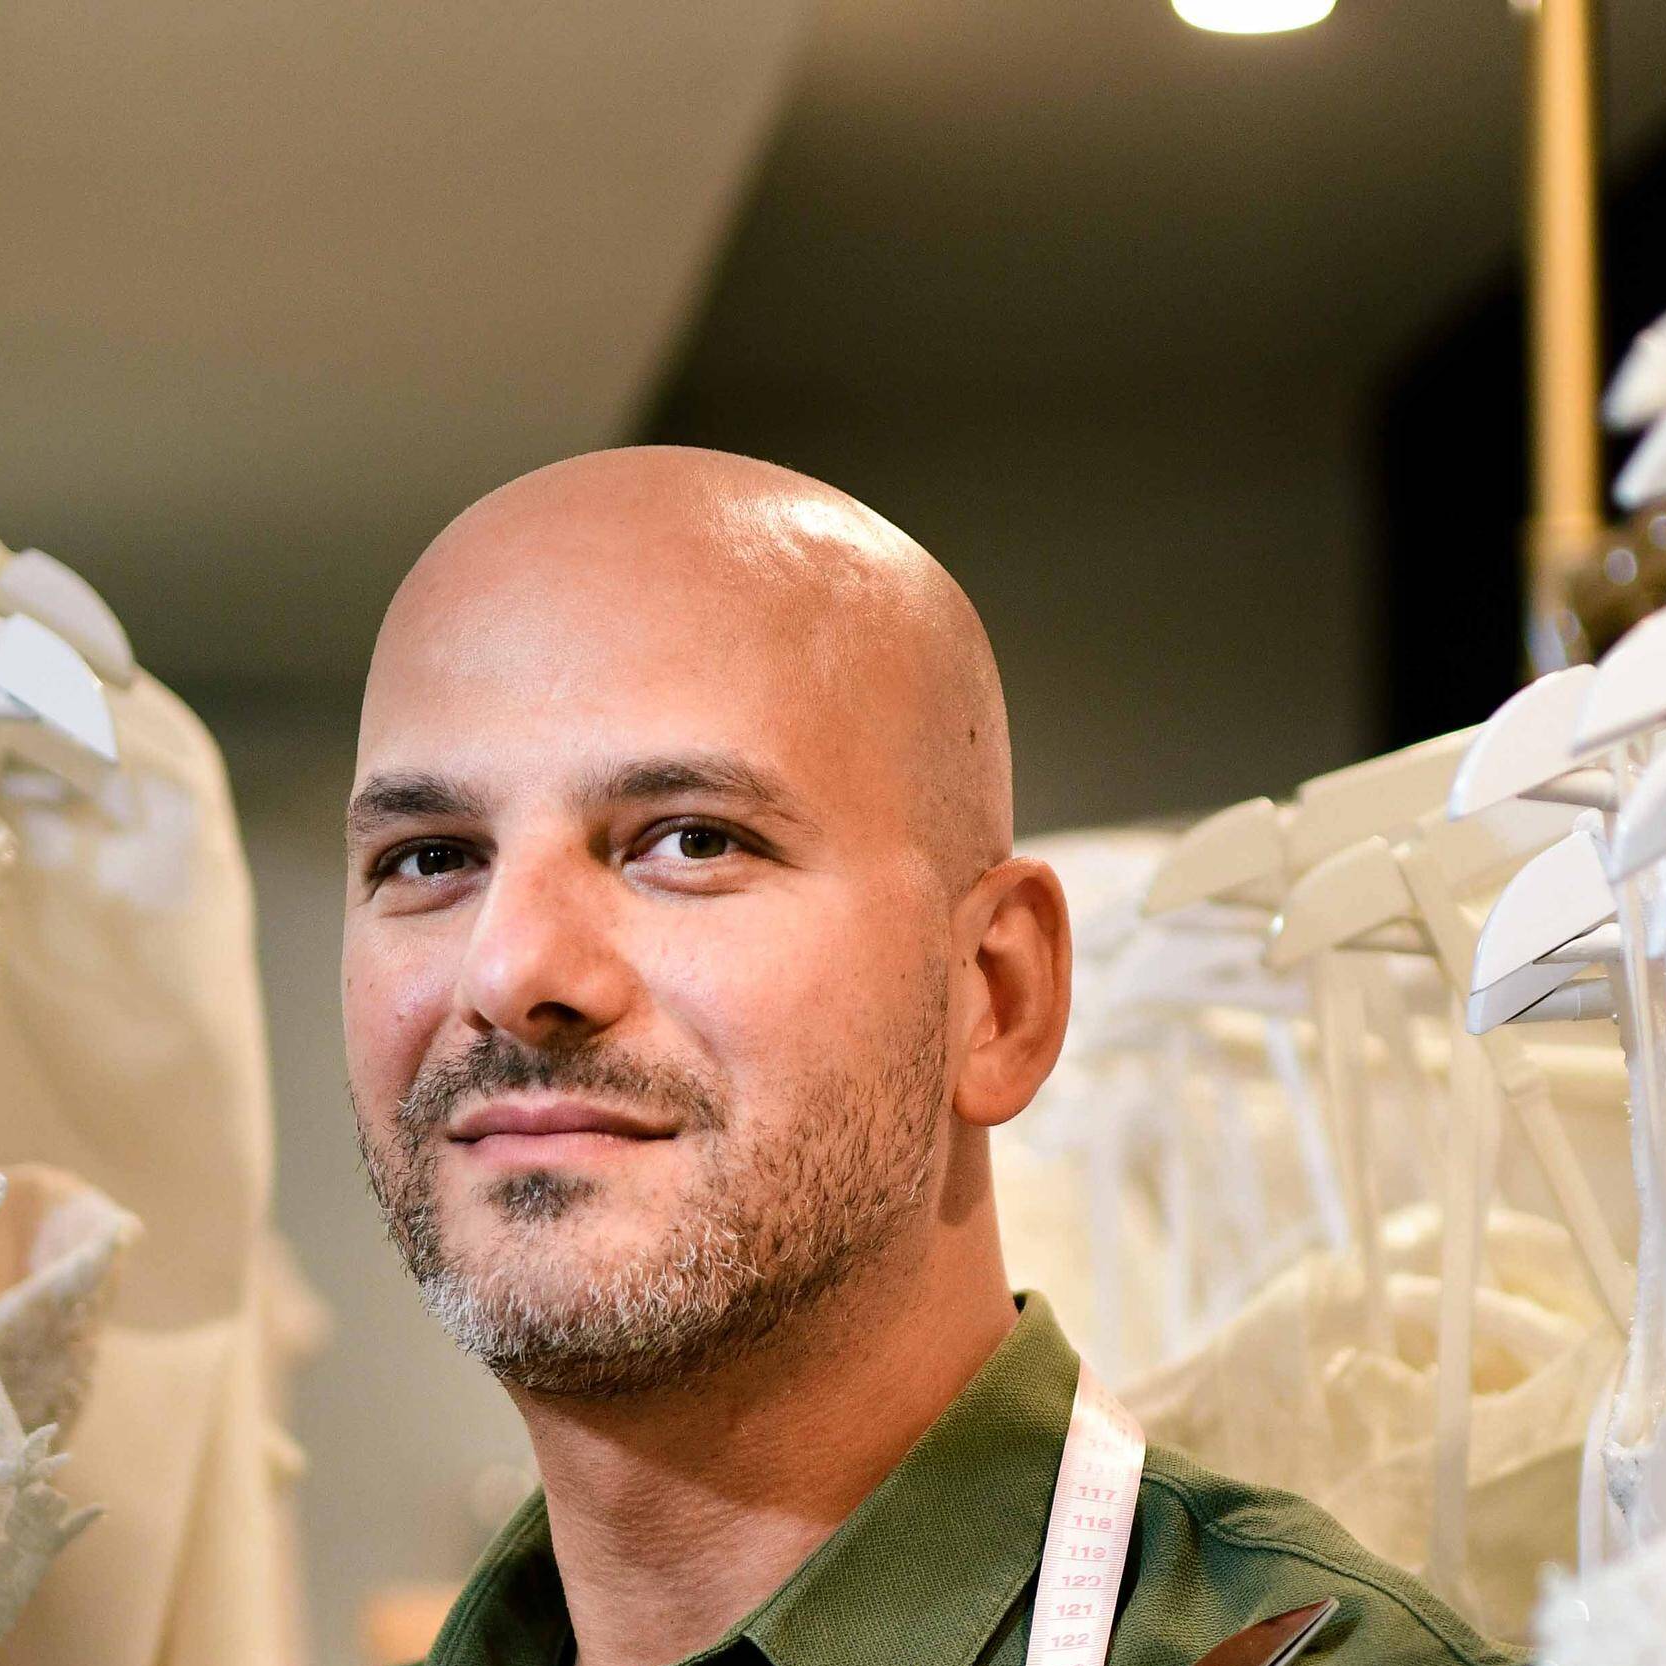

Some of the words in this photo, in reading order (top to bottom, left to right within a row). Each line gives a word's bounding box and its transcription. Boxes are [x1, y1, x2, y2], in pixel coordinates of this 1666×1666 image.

[1077, 1485, 1117, 1501] 117
[1073, 1514, 1113, 1531] 118
[1067, 1544, 1107, 1560] 119
[1061, 1574, 1102, 1588] 120
[1056, 1603, 1094, 1617] 121
[1050, 1632, 1090, 1648] 122
